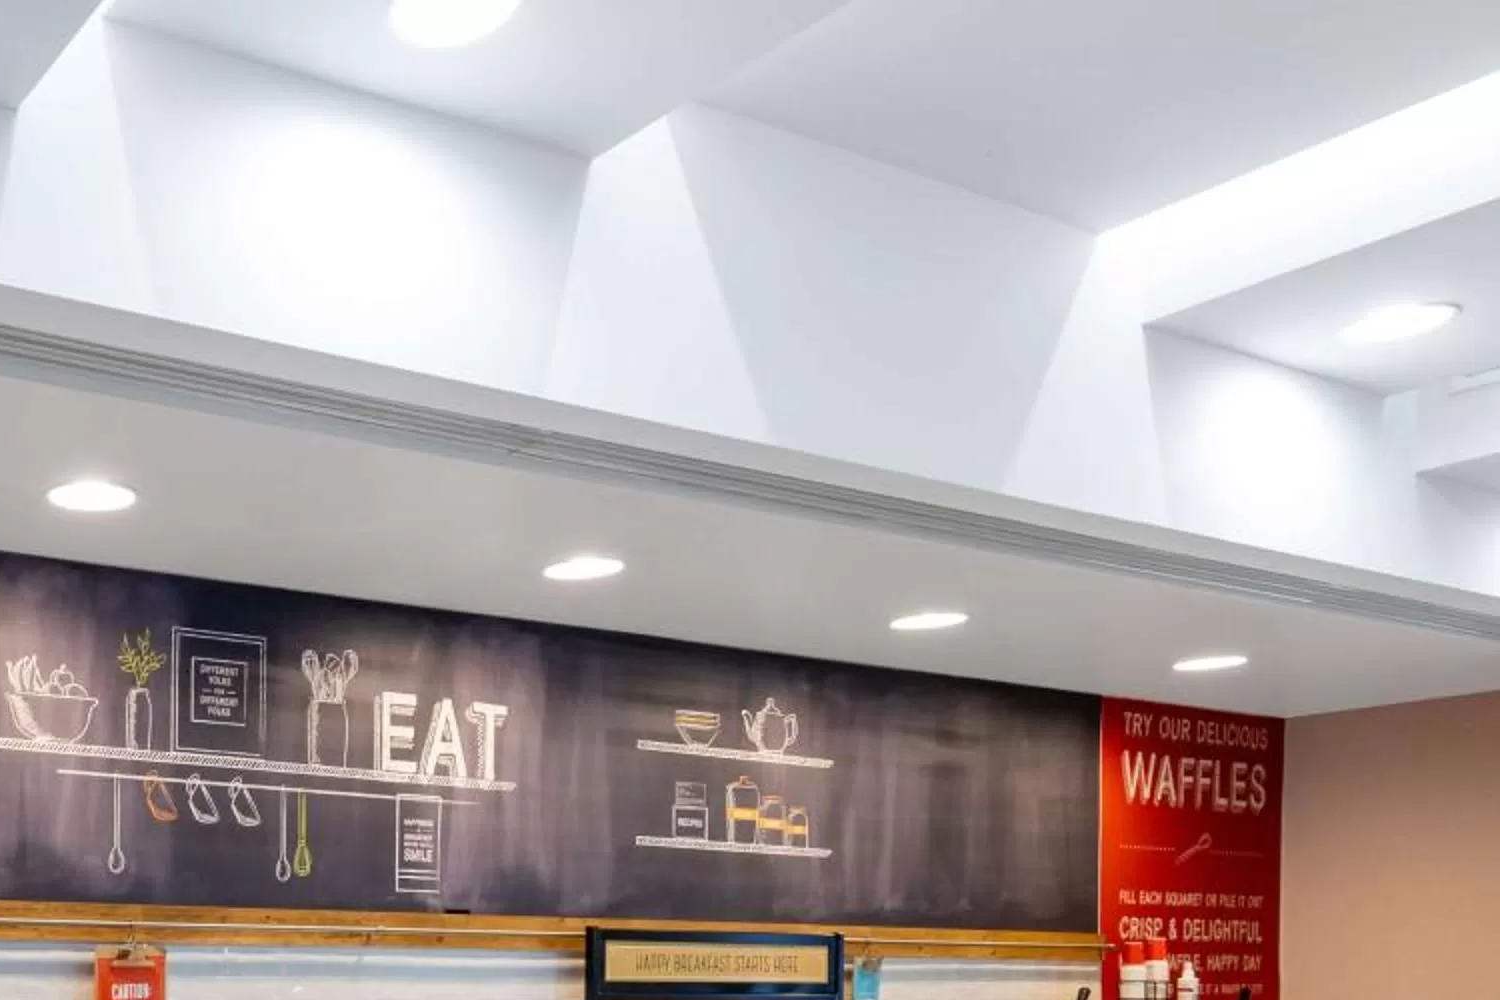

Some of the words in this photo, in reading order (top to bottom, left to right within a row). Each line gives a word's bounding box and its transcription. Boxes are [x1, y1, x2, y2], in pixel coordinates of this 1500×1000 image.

[373, 691, 509, 785] EAT
[1124, 711, 1153, 737] TRY
[1159, 716, 1191, 741] OUR
[1196, 719, 1268, 750] DELICIOUS
[1121, 749, 1267, 816] WAFFLES
[1119, 889, 1136, 905] FILL
[1139, 890, 1162, 906] EACH
[1119, 916, 1163, 940] CRISP
[1168, 918, 1177, 941] &
[1182, 918, 1263, 943] DELIGHTFUL
[635, 953, 671, 972] HAPPY
[674, 954, 731, 973] BREAKFAST
[733, 955, 770, 973] STARTS
[773, 956, 799, 973] HERE
[1206, 955, 1240, 971] HAPPY
[1243, 955, 1263, 972] DAY
